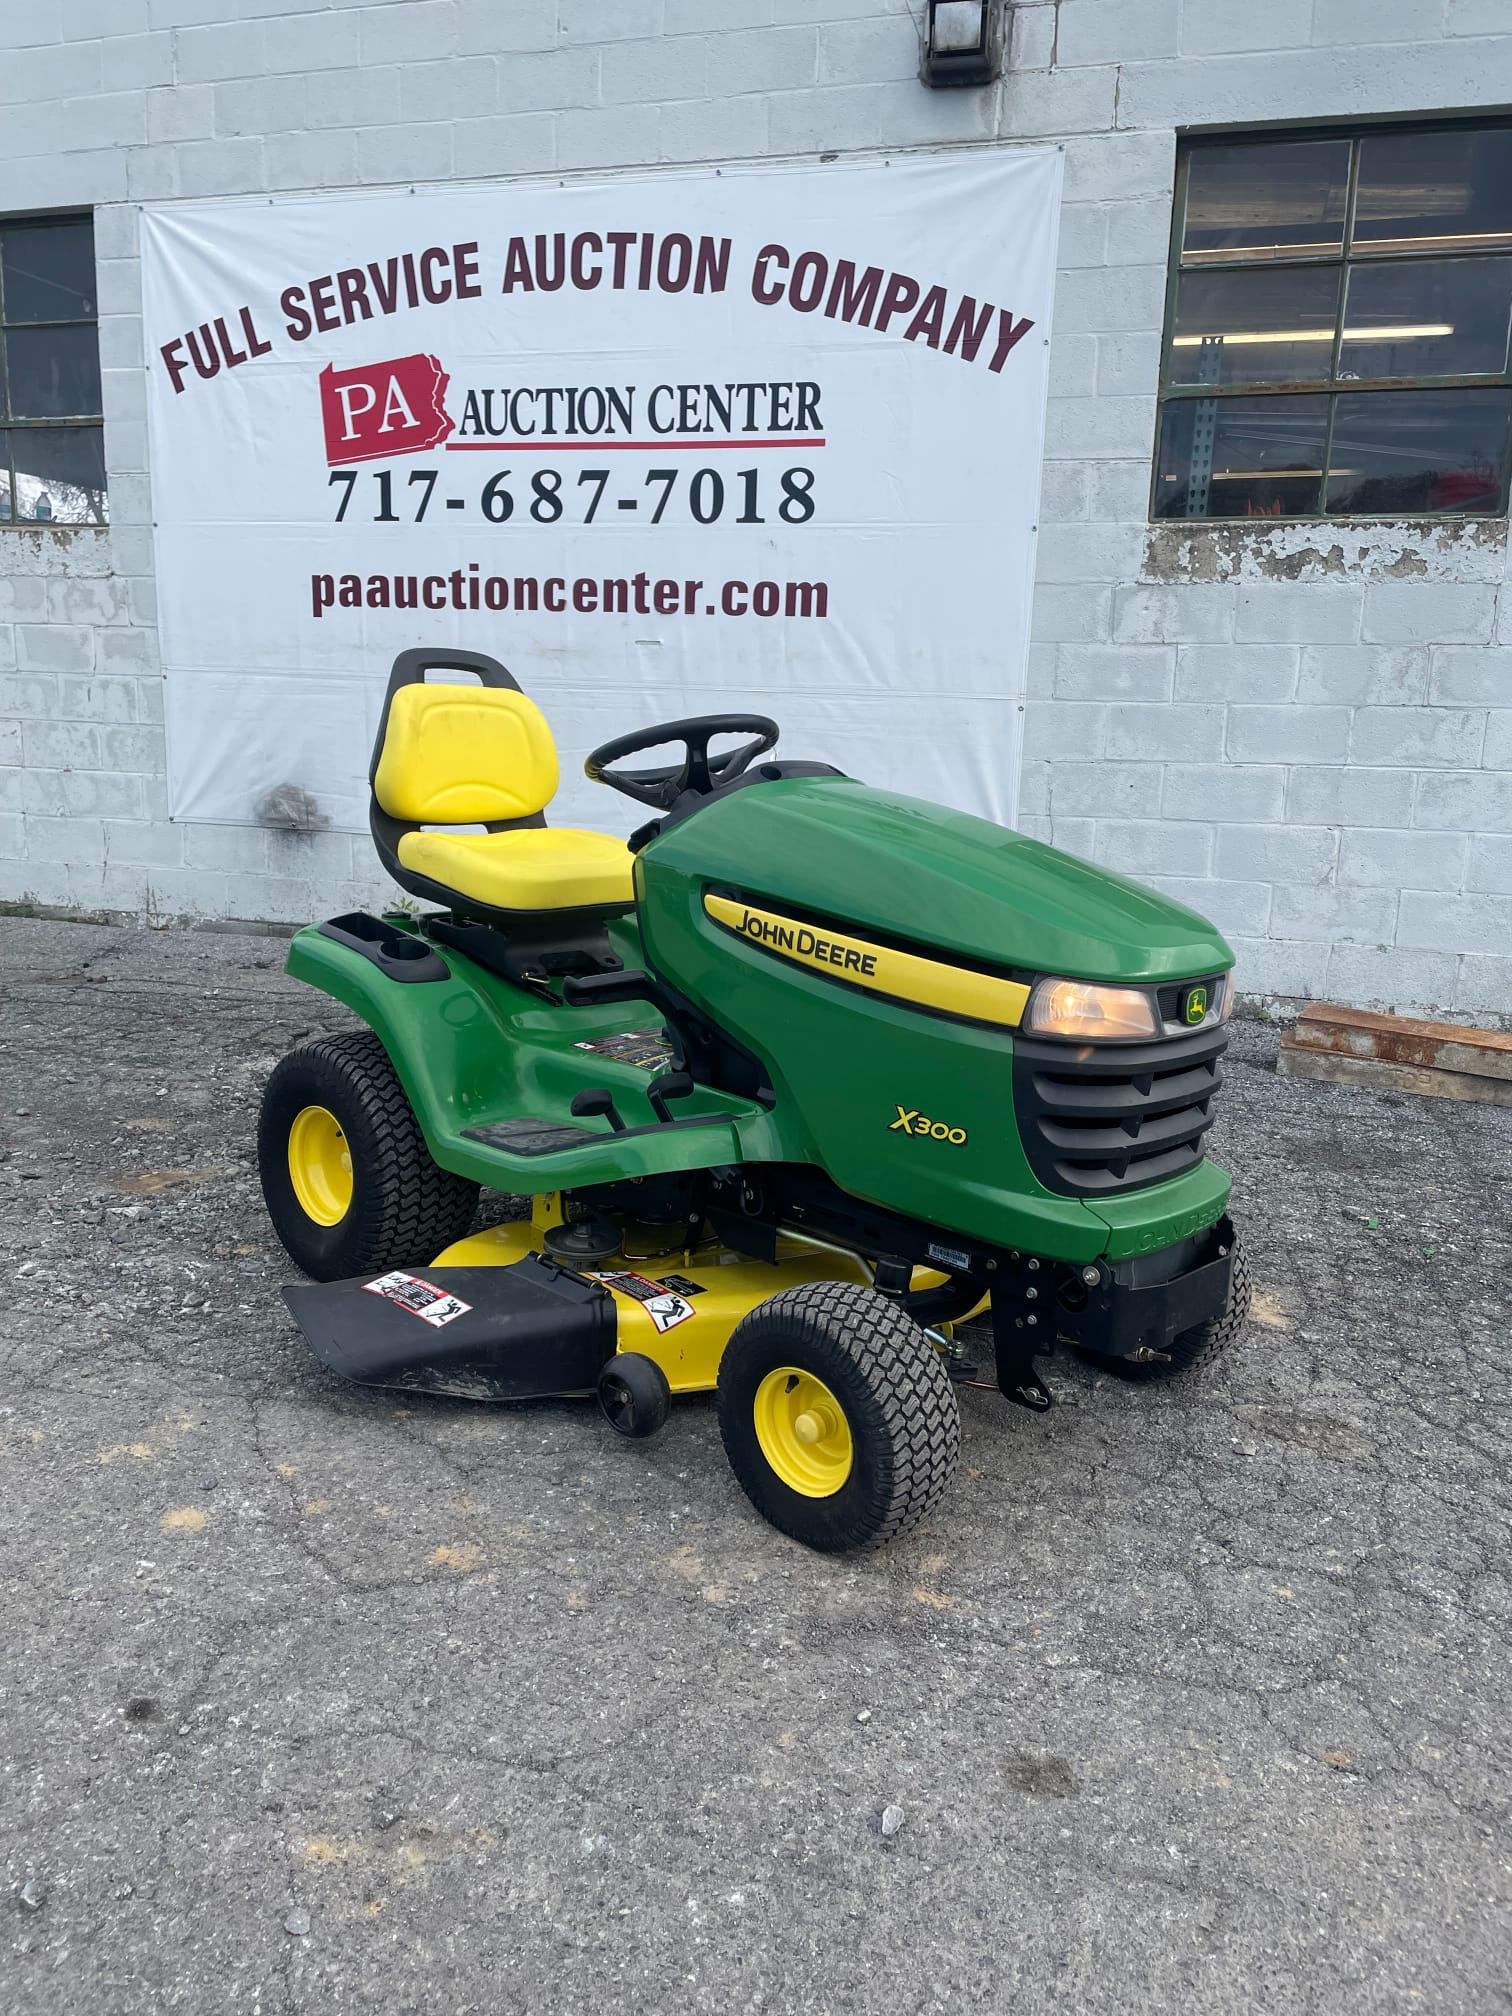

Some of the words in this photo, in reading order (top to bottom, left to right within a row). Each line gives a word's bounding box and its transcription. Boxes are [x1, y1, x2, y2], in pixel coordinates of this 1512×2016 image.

[159, 305, 273, 395] FULL
[279, 241, 481, 343] SERVICE
[502, 231, 733, 296] AUCTION
[751, 243, 1036, 375] COMPANY
[333, 374, 422, 442] PA
[458, 385, 637, 437] AUCTION
[647, 381, 825, 435] CENTER
[327, 467, 816, 525] 717-687-7018
[311, 563, 829, 619] paauctioncenter.com
[735, 909, 795, 951] JOHN
[796, 928, 878, 977] DEERE
[888, 1104, 969, 1148] X300
